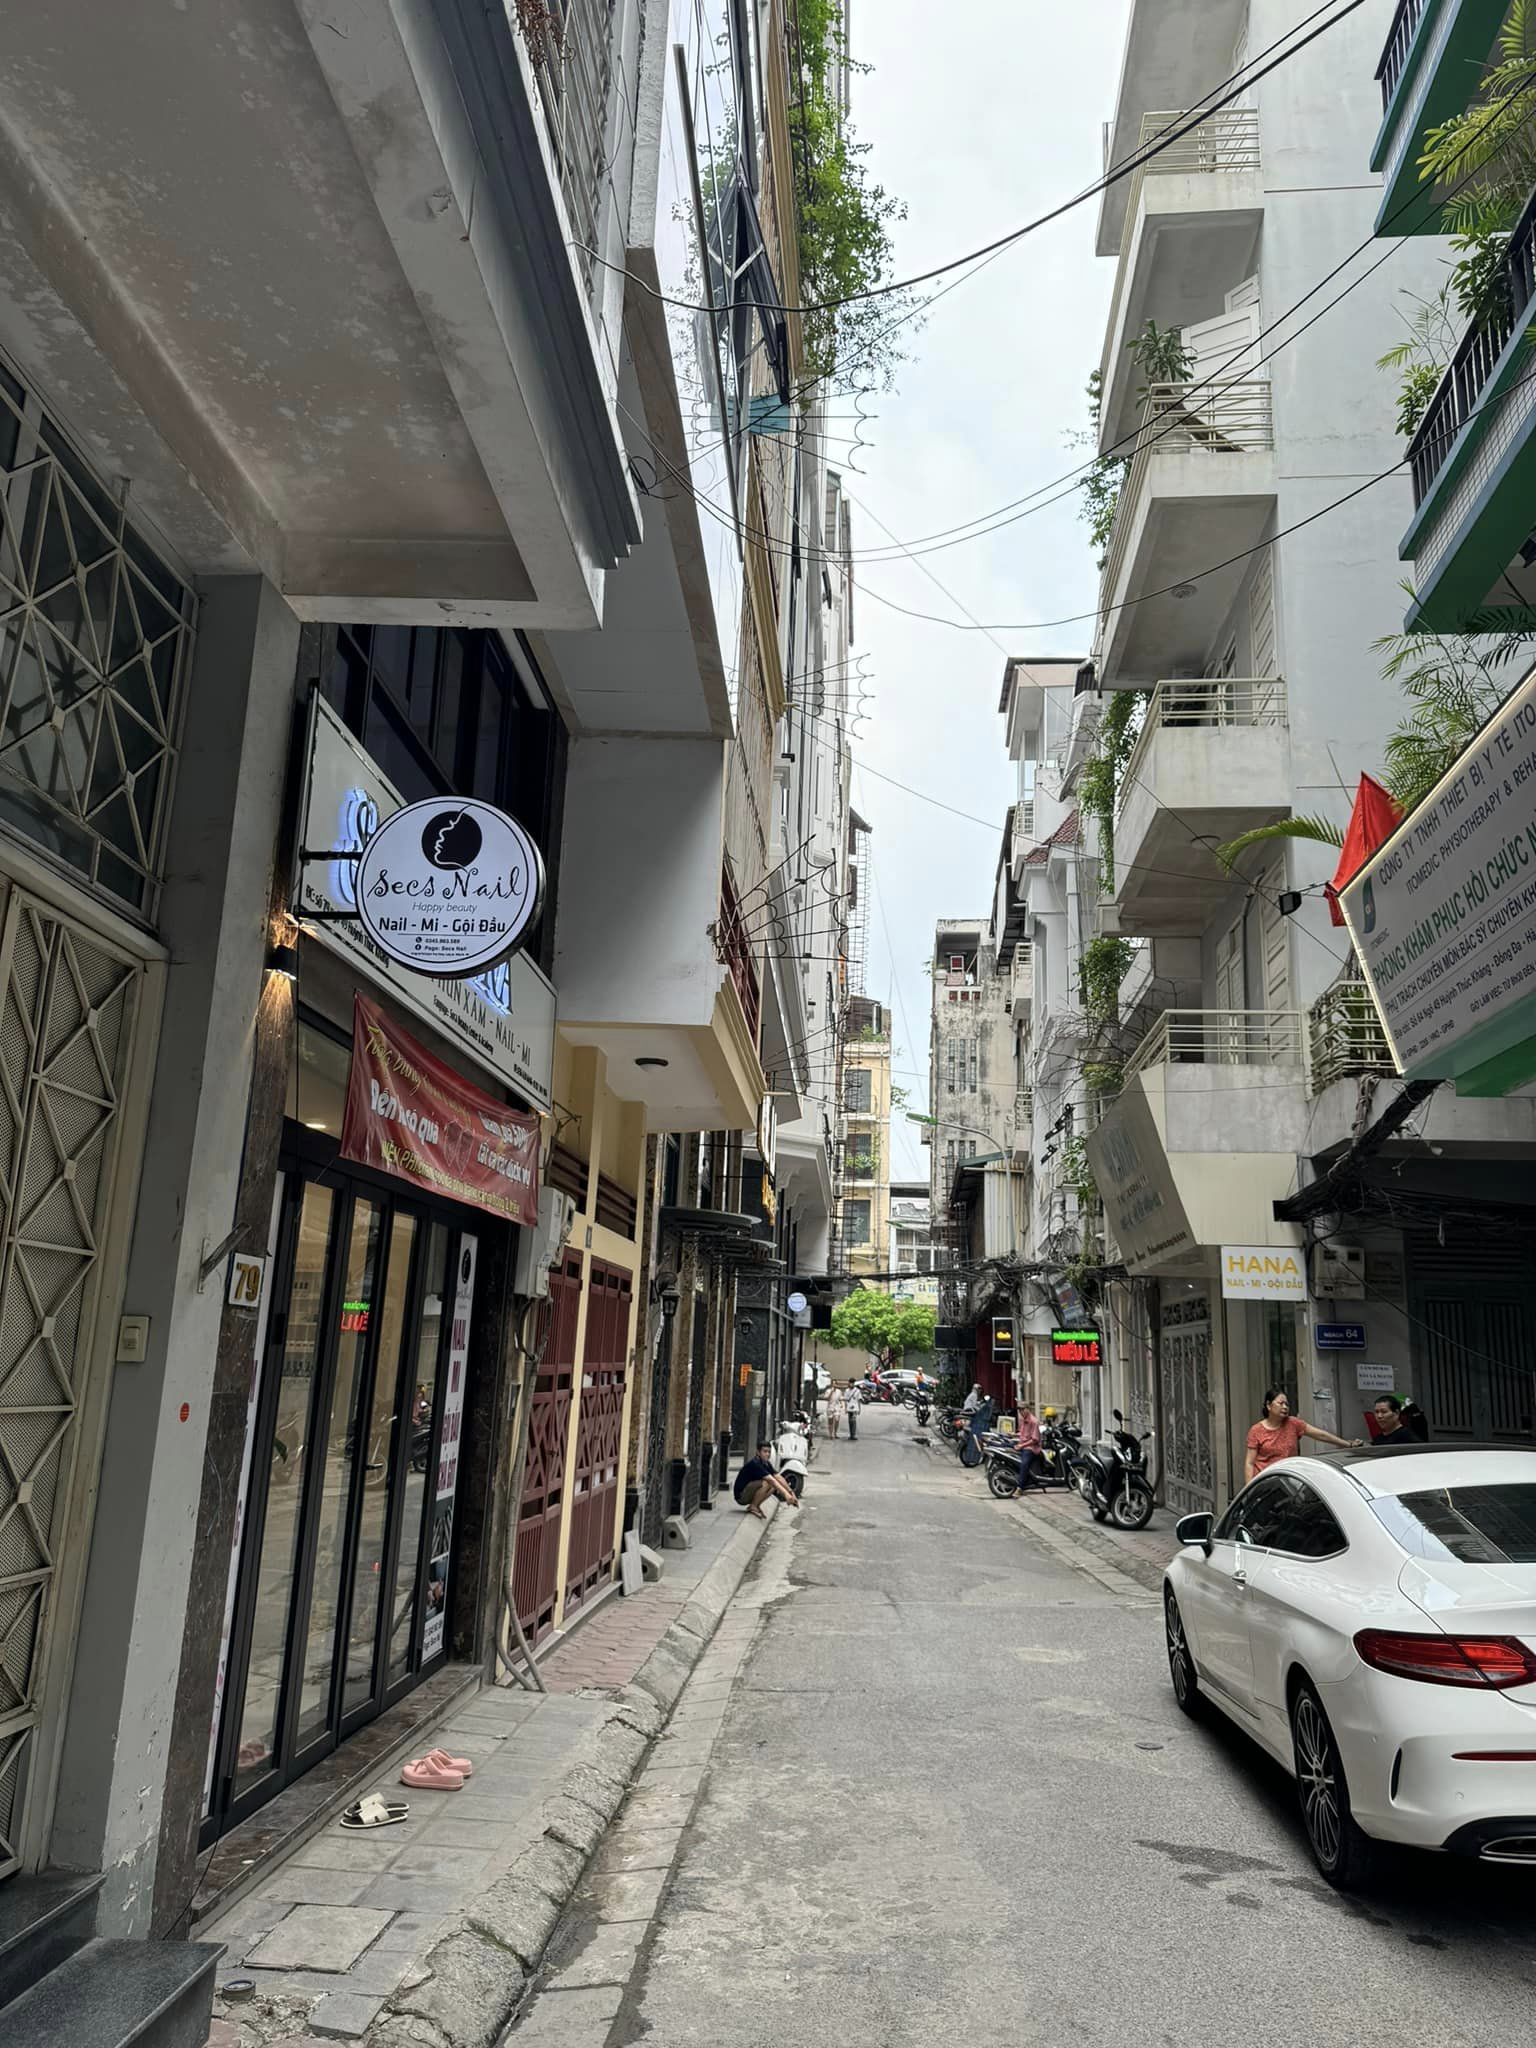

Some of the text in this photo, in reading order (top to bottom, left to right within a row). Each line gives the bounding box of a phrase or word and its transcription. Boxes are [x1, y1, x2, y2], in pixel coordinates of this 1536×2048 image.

[1401, 835, 1415, 860] TY
[1414, 808, 1441, 846] TNHH
[1469, 761, 1486, 785] BỊ
[1482, 747, 1494, 770] Y
[1494, 724, 1514, 757] TẾ
[1406, 853, 1440, 895] ITOMEDIC
[1440, 787, 1502, 861] PHYSIOTHERAPY
[1503, 780, 1513, 796] &
[367, 866, 522, 899] Secs Nail
[379, 917, 407, 931] Nail
[421, 918, 438, 932] Mi
[452, 919, 474, 936] Gội
[479, 916, 505, 933] Đầu
[412, 901, 477, 914] Happy beauty
[1372, 945, 1407, 991] PHÒNG
[1402, 919, 1436, 965] KHÁM
[1432, 891, 1466, 938] PHỤC
[1486, 834, 1529, 890] CHỨC
[1385, 997, 1400, 1016] PHỤ
[1396, 979, 1419, 1006] TRÁCH
[1416, 960, 1444, 991] CHUYÊN
[1487, 896, 1523, 934] CHUYÊN
[495, 1017, 515, 1054] NAIL
[521, 1041, 530, 1067] MI
[234, 1262, 260, 1302] 79
[1228, 1256, 1298, 1275] HANA
[1345, 1328, 1358, 1338] 64
